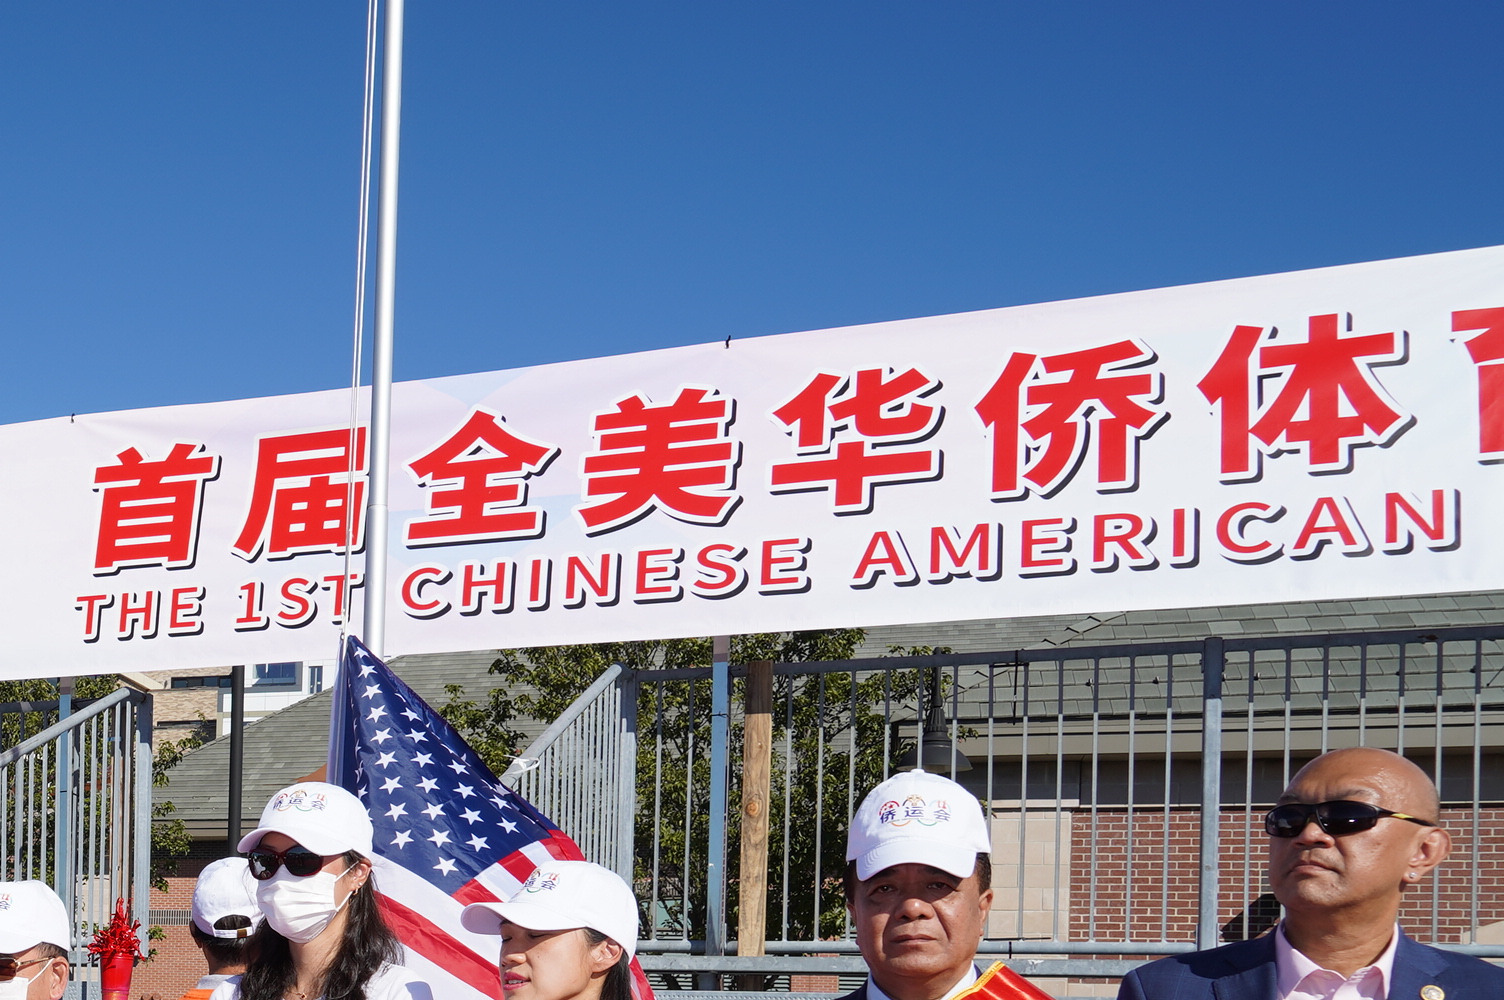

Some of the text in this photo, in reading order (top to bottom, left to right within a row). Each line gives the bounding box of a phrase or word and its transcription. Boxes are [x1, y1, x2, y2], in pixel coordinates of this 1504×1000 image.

[75, 488, 1462, 643] THE 1ST CHINESE AMERICAN
[880, 805, 951, 824] 侨运会
